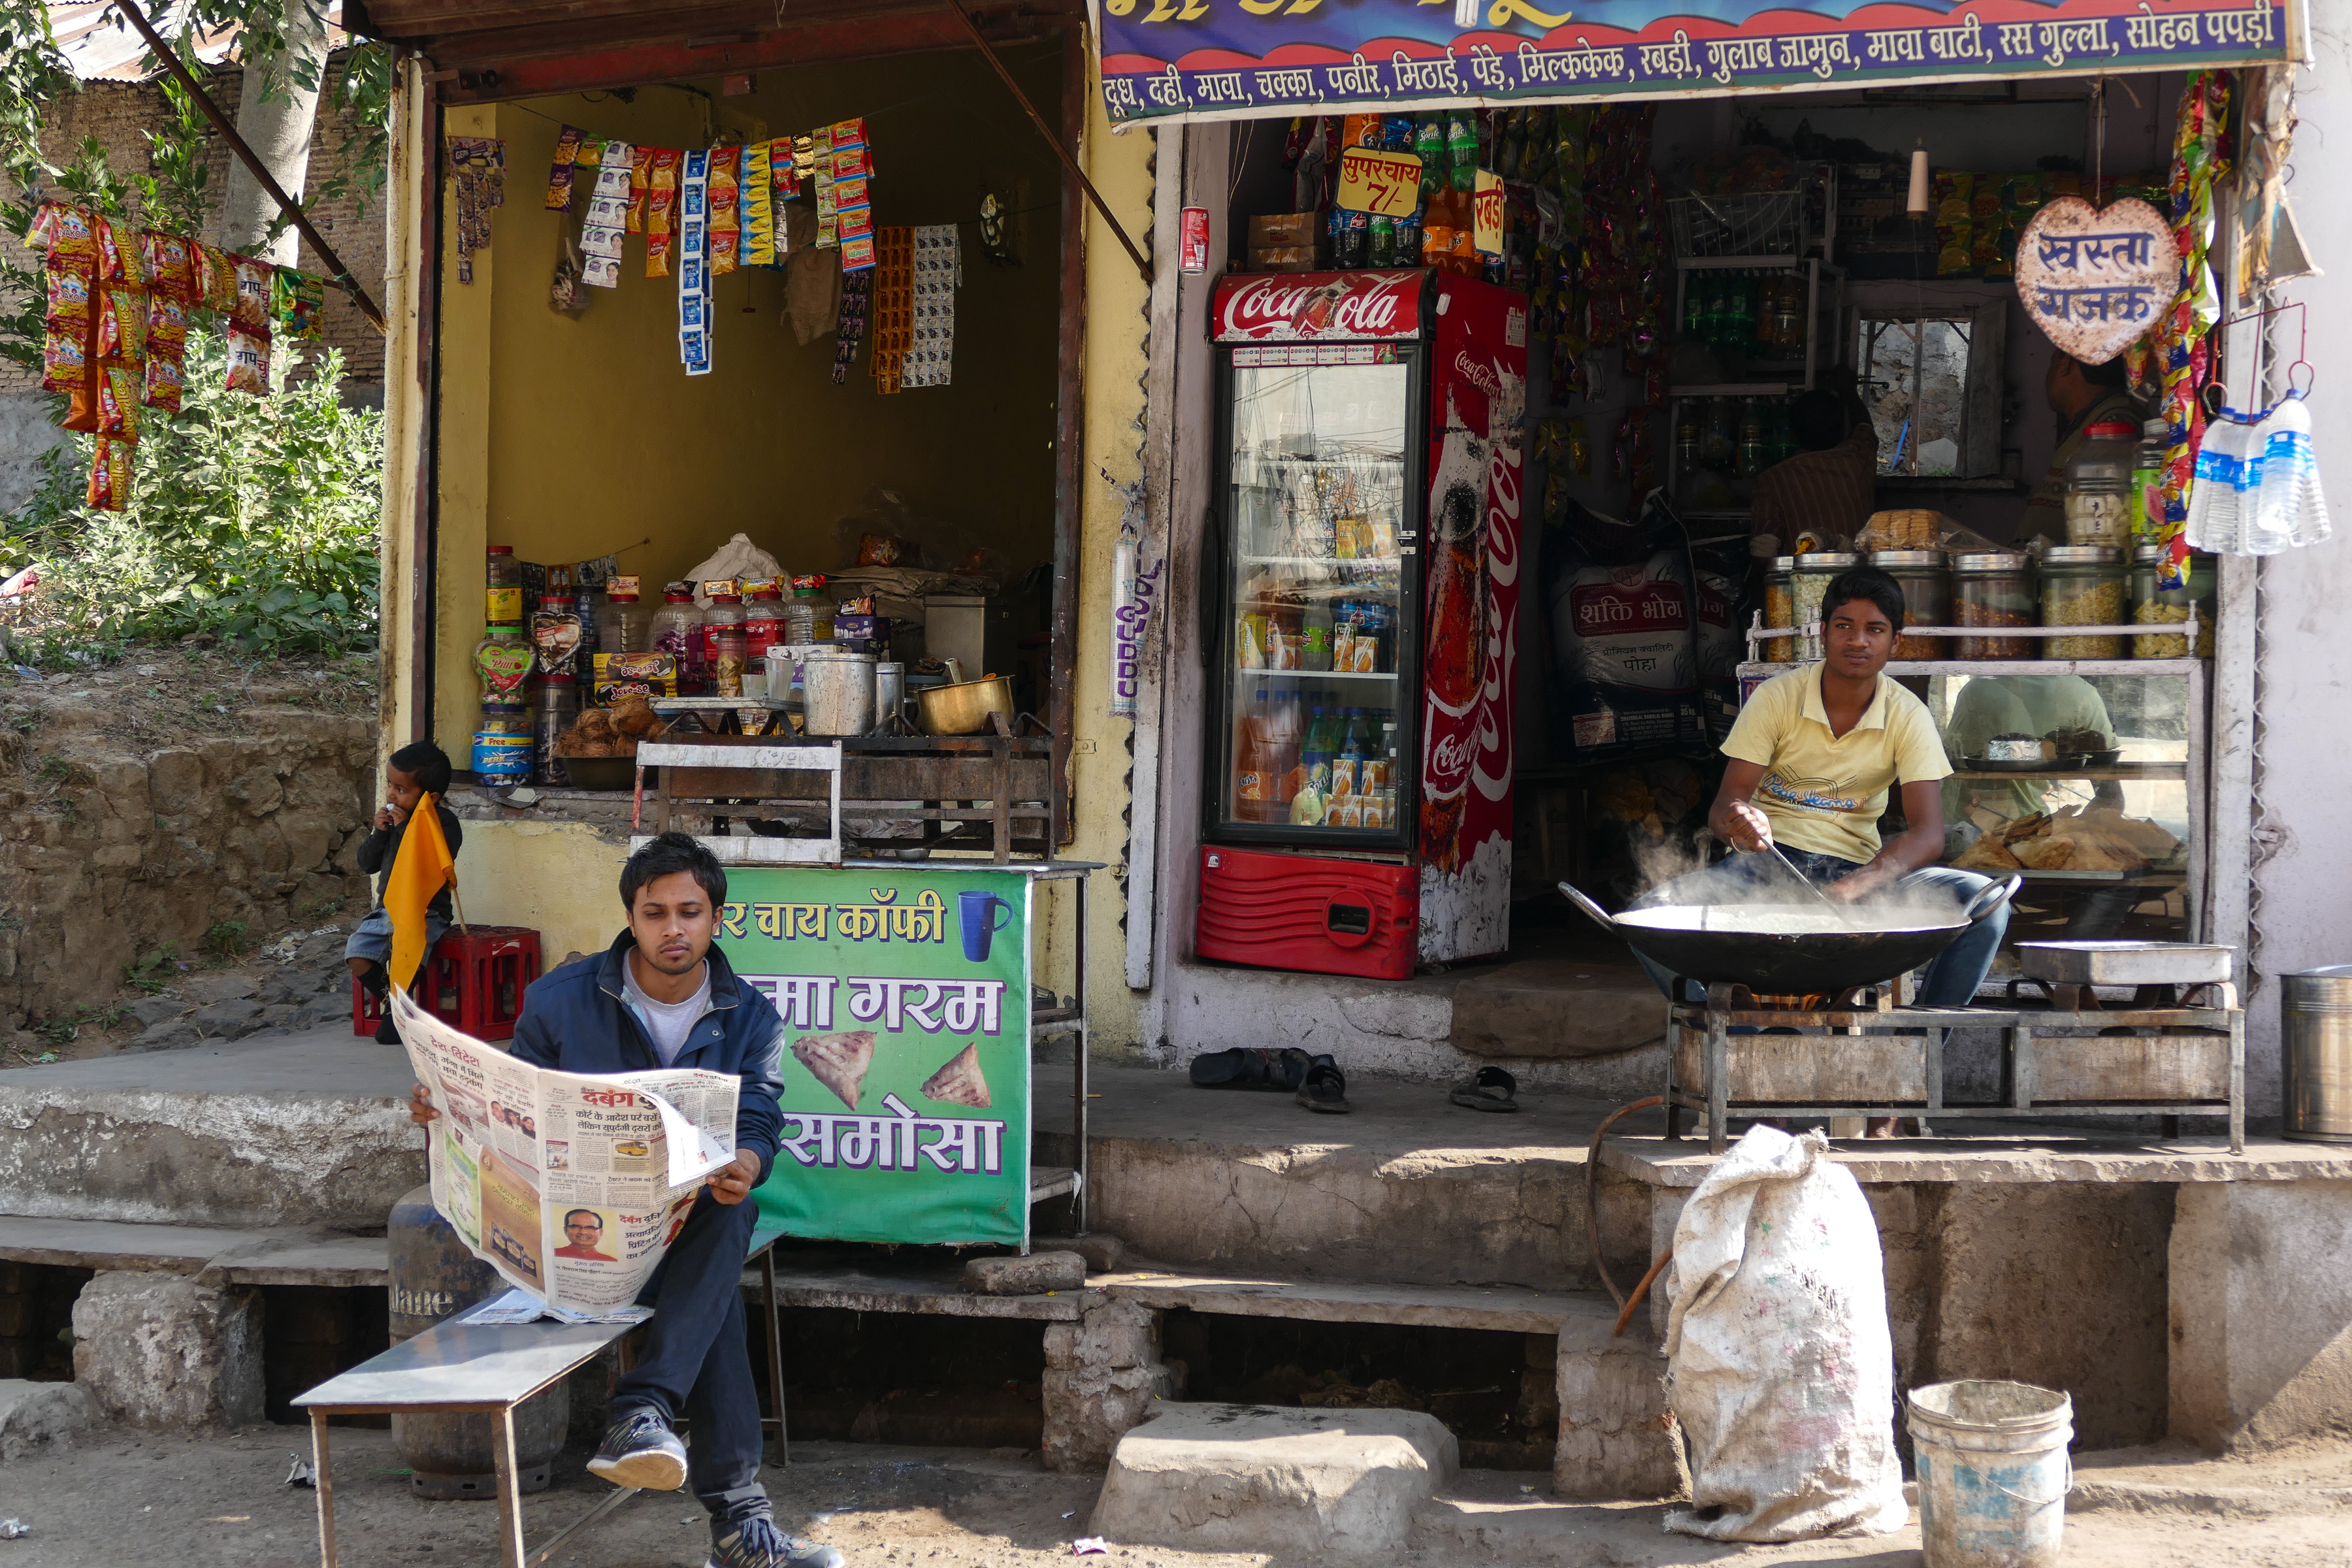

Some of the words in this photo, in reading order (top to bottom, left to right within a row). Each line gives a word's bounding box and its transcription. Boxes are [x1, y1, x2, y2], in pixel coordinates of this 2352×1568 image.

[1102, 78, 1145, 118] दूध,
[1146, 63, 1194, 109] दही,
[1194, 72, 1253, 107] मावा,
[1254, 68, 1325, 103] चक्का,
[1326, 51, 1390, 99] पनीर,
[1392, 46, 1469, 95] मिठाई,
[1471, 44, 1515, 91] पेड़े,
[1518, 37, 1635, 84] मिल्ककेक,
[1639, 29, 1703, 80] रबड़ी,
[1706, 38, 1775, 84] गुलाब
[1777, 33, 1861, 79] जामुन,
[1865, 29, 1925, 61] मावा
[1927, 12, 1993, 64] बाटी,
[1998, 23, 2034, 56] रस
[2038, 18, 2120, 67] गुल्ला,
[2125, 2, 2201, 50] सोहन
[2205, 0, 2275, 49] पपड़ी
[1420, 129, 1441, 142] Sprite
[1448, 127, 1466, 142] Sprite
[1475, 178, 1505, 240] रबड़ी
[59, 228, 91, 239] NAKODA
[116, 227, 137, 281] Noodles
[58, 291, 89, 302] NAKODA
[2038, 286, 2155, 322] गजक
[120, 303, 135, 359] Noodles
[55, 353, 86, 365] NAKODA
[116, 379, 135, 434] Noodles
[1580, 595, 1633, 624] शक्ति
[1642, 592, 1684, 619] भोग
[1115, 606, 1138, 697] GUDDU
[1603, 645, 1637, 657] प्रीमियम
[1639, 643, 1674, 653] क्वालिटी
[1623, 655, 1657, 673] पोहा
[1680, 708, 1690, 716] 35
[489, 738, 506, 746] Free
[1307, 769, 1333, 798] Sprite
[1801, 788, 1859, 809] Jeans
[1792, 804, 1835, 815] GENERATION
[754, 902, 830, 939] चाय
[836, 888, 948, 943] कॉफी
[847, 975, 1007, 1037] गरम
[430, 1034, 480, 1068] देश-विदेश
[441, 1056, 458, 1070] गंगा
[467, 1068, 484, 1082] मिले
[442, 1065, 458, 1077] मचा
[580, 1088, 635, 1107] दबंग
[576, 1109, 593, 1120] कोर्ट
[594, 1110, 603, 1121] के
[604, 1111, 629, 1122] आदेश
[578, 1120, 600, 1131] लेकिन
[602, 1122, 630, 1133] सुपुर्दगी
[631, 1124, 651, 1135] दूसरों
[652, 1122, 662, 1131] को
[781, 1092, 1007, 1175] समोसा
[619, 1215, 642, 1224] दबंग
